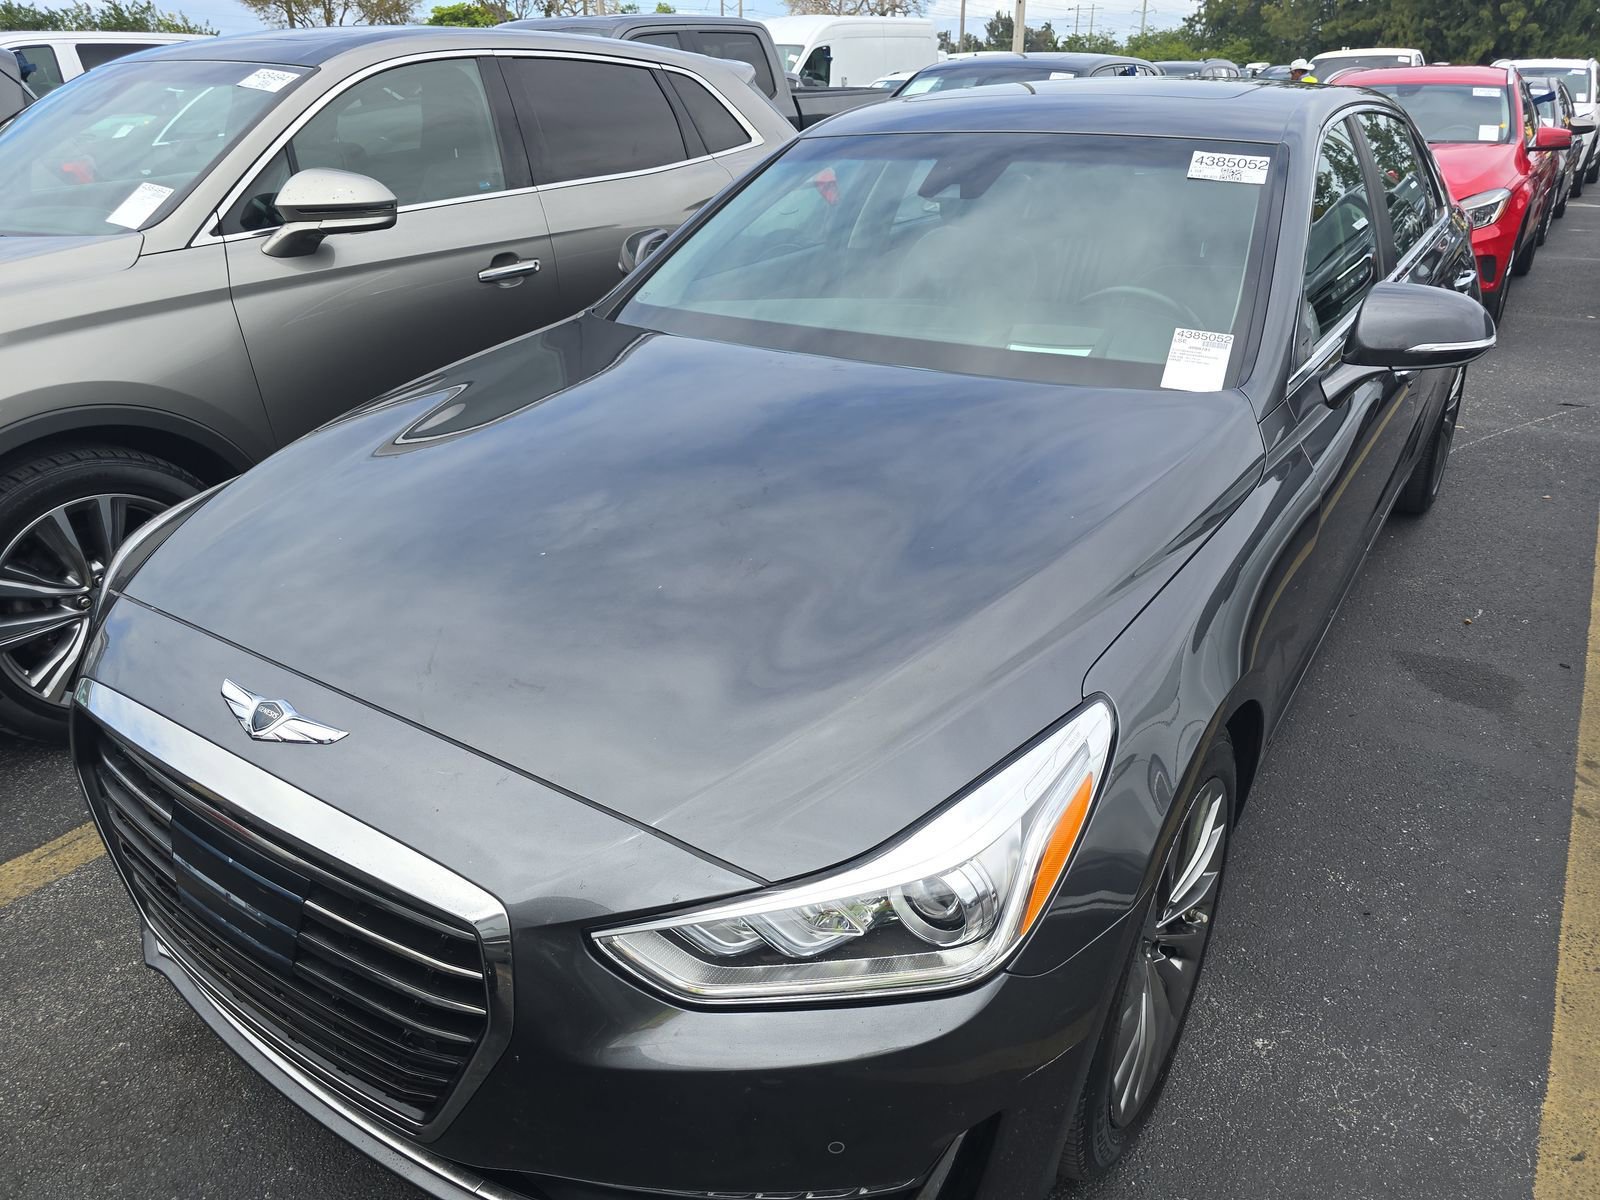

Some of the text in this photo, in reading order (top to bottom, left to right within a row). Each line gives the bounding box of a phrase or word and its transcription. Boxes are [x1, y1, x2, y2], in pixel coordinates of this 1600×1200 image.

[1195, 155, 1269, 171] 4385052
[1177, 330, 1233, 345] 4385052
[258, 705, 279, 719] GENESIS
